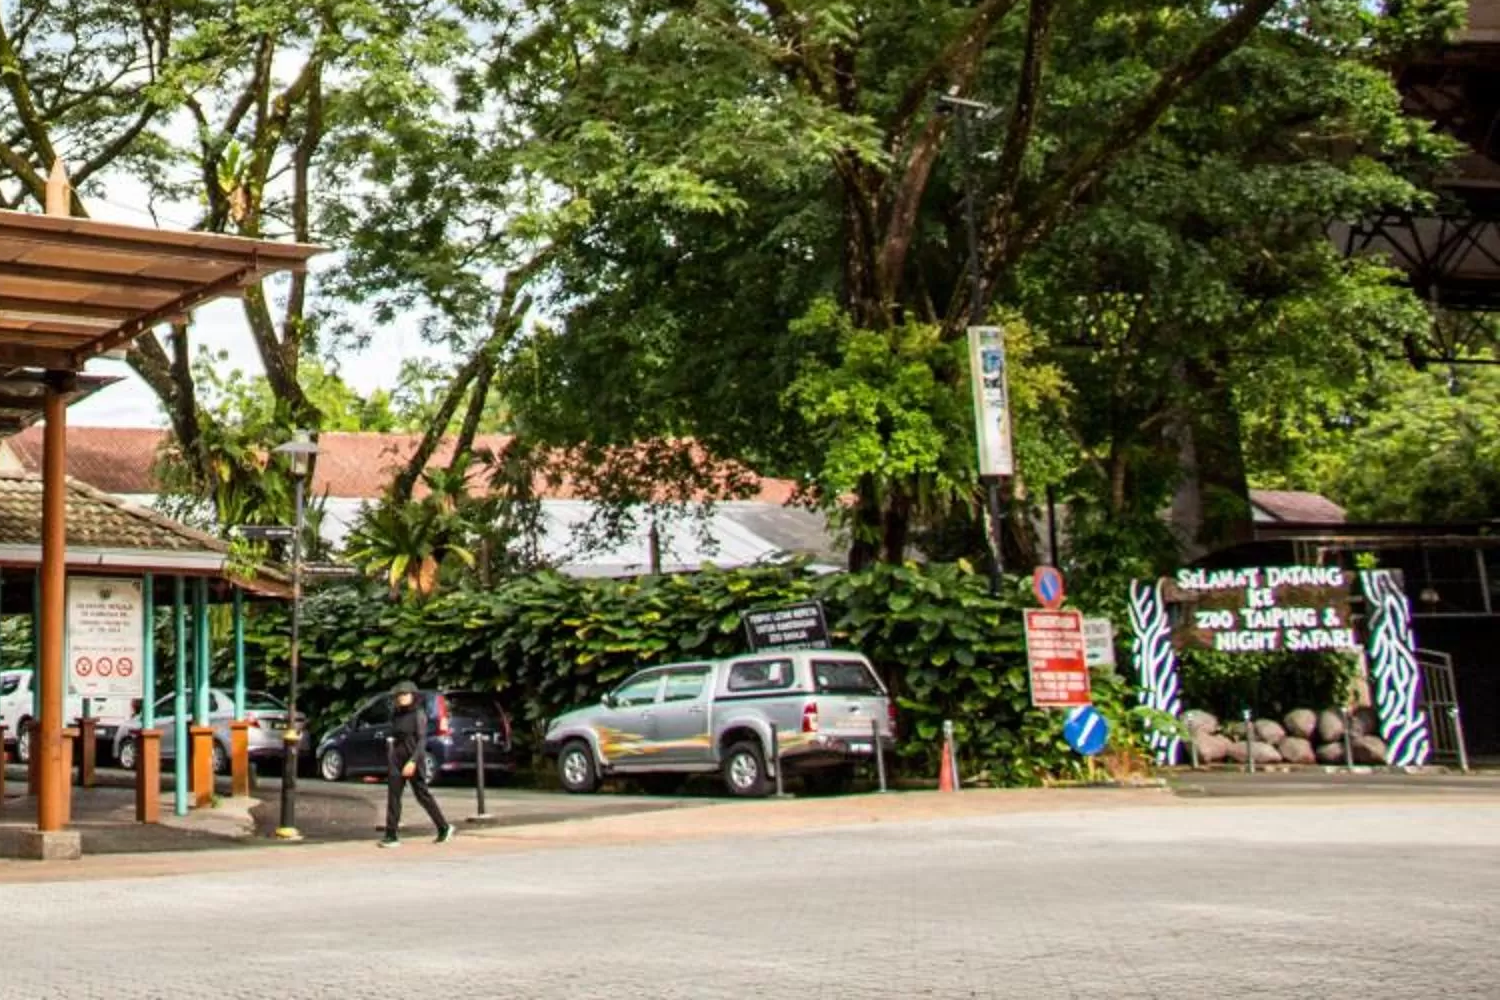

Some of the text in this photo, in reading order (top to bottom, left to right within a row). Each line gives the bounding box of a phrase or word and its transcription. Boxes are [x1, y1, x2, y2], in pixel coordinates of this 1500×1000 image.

[1267, 567, 1343, 587] DATANG
[1247, 588, 1274, 607] KE
[1194, 608, 1341, 628] ZOO TAIPING &
[1216, 629, 1354, 650] NIGHT SAFARI
